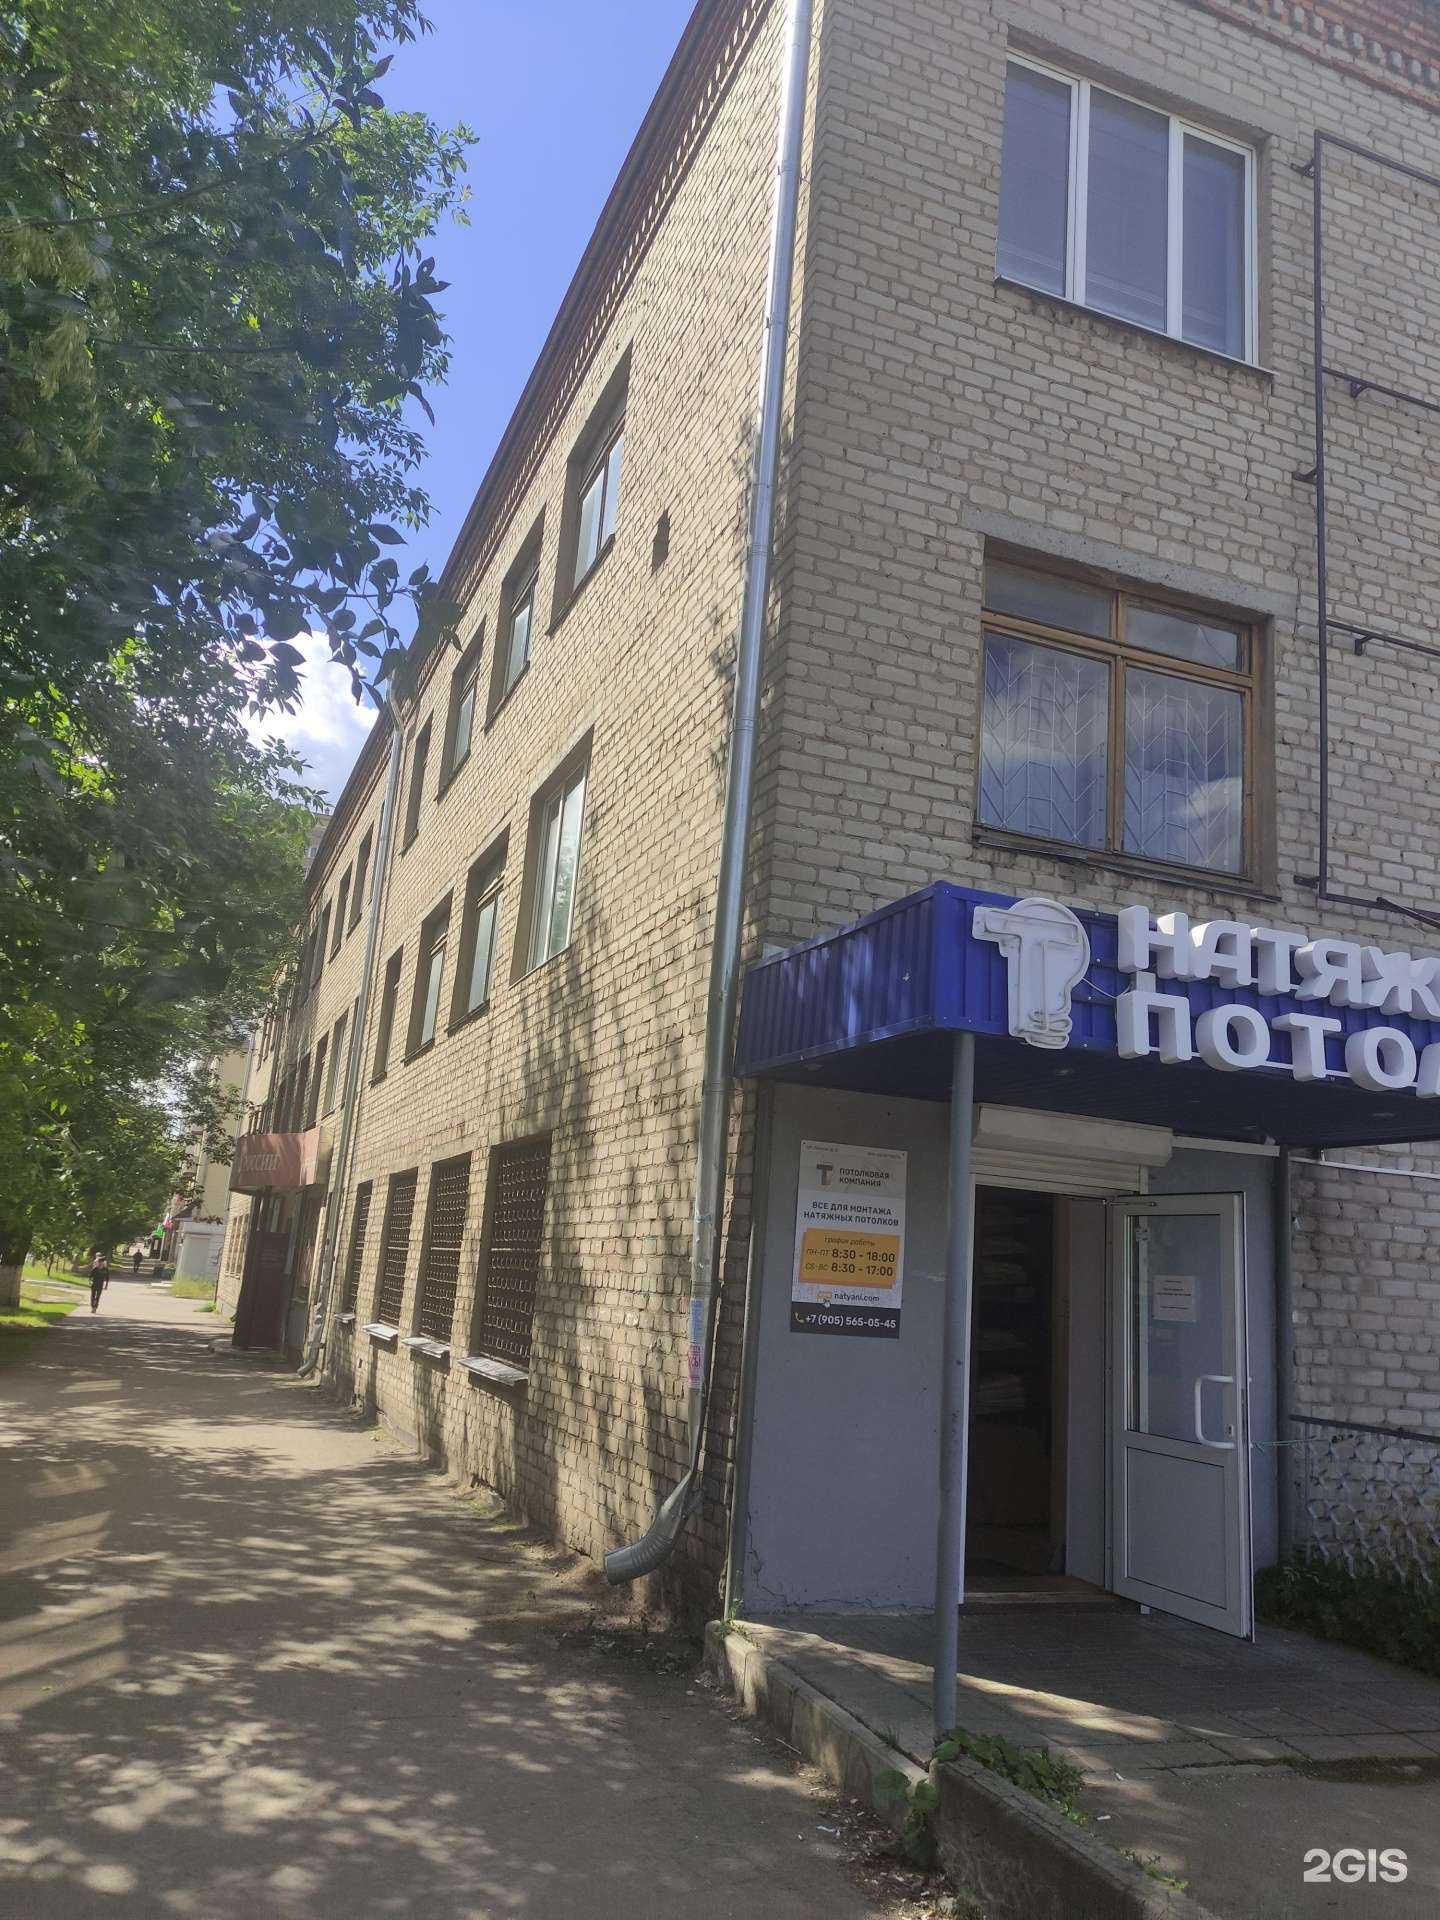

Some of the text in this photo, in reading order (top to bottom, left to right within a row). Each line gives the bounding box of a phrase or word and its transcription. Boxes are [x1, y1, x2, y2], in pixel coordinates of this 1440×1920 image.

[839, 1167, 890, 1180] ПОТОЛКОВАЯ
[839, 1176, 881, 1187] КОМПАНИЯ
[812, 1201, 892, 1216] ВСЕ ДЛЯ МОНТАЖА
[803, 1210, 899, 1227] НАТЯЖНЫХ ПОТОЛКОВ
[832, 1248, 856, 1260] 8:30
[866, 1251, 895, 1263] 18:00
[831, 1262, 855, 1274] 8:30
[865, 1265, 893, 1277] 17:00
[833, 1292, 880, 1303] natyani.com
[806, 1313, 896, 1329] +7 (905) 565-05-45
